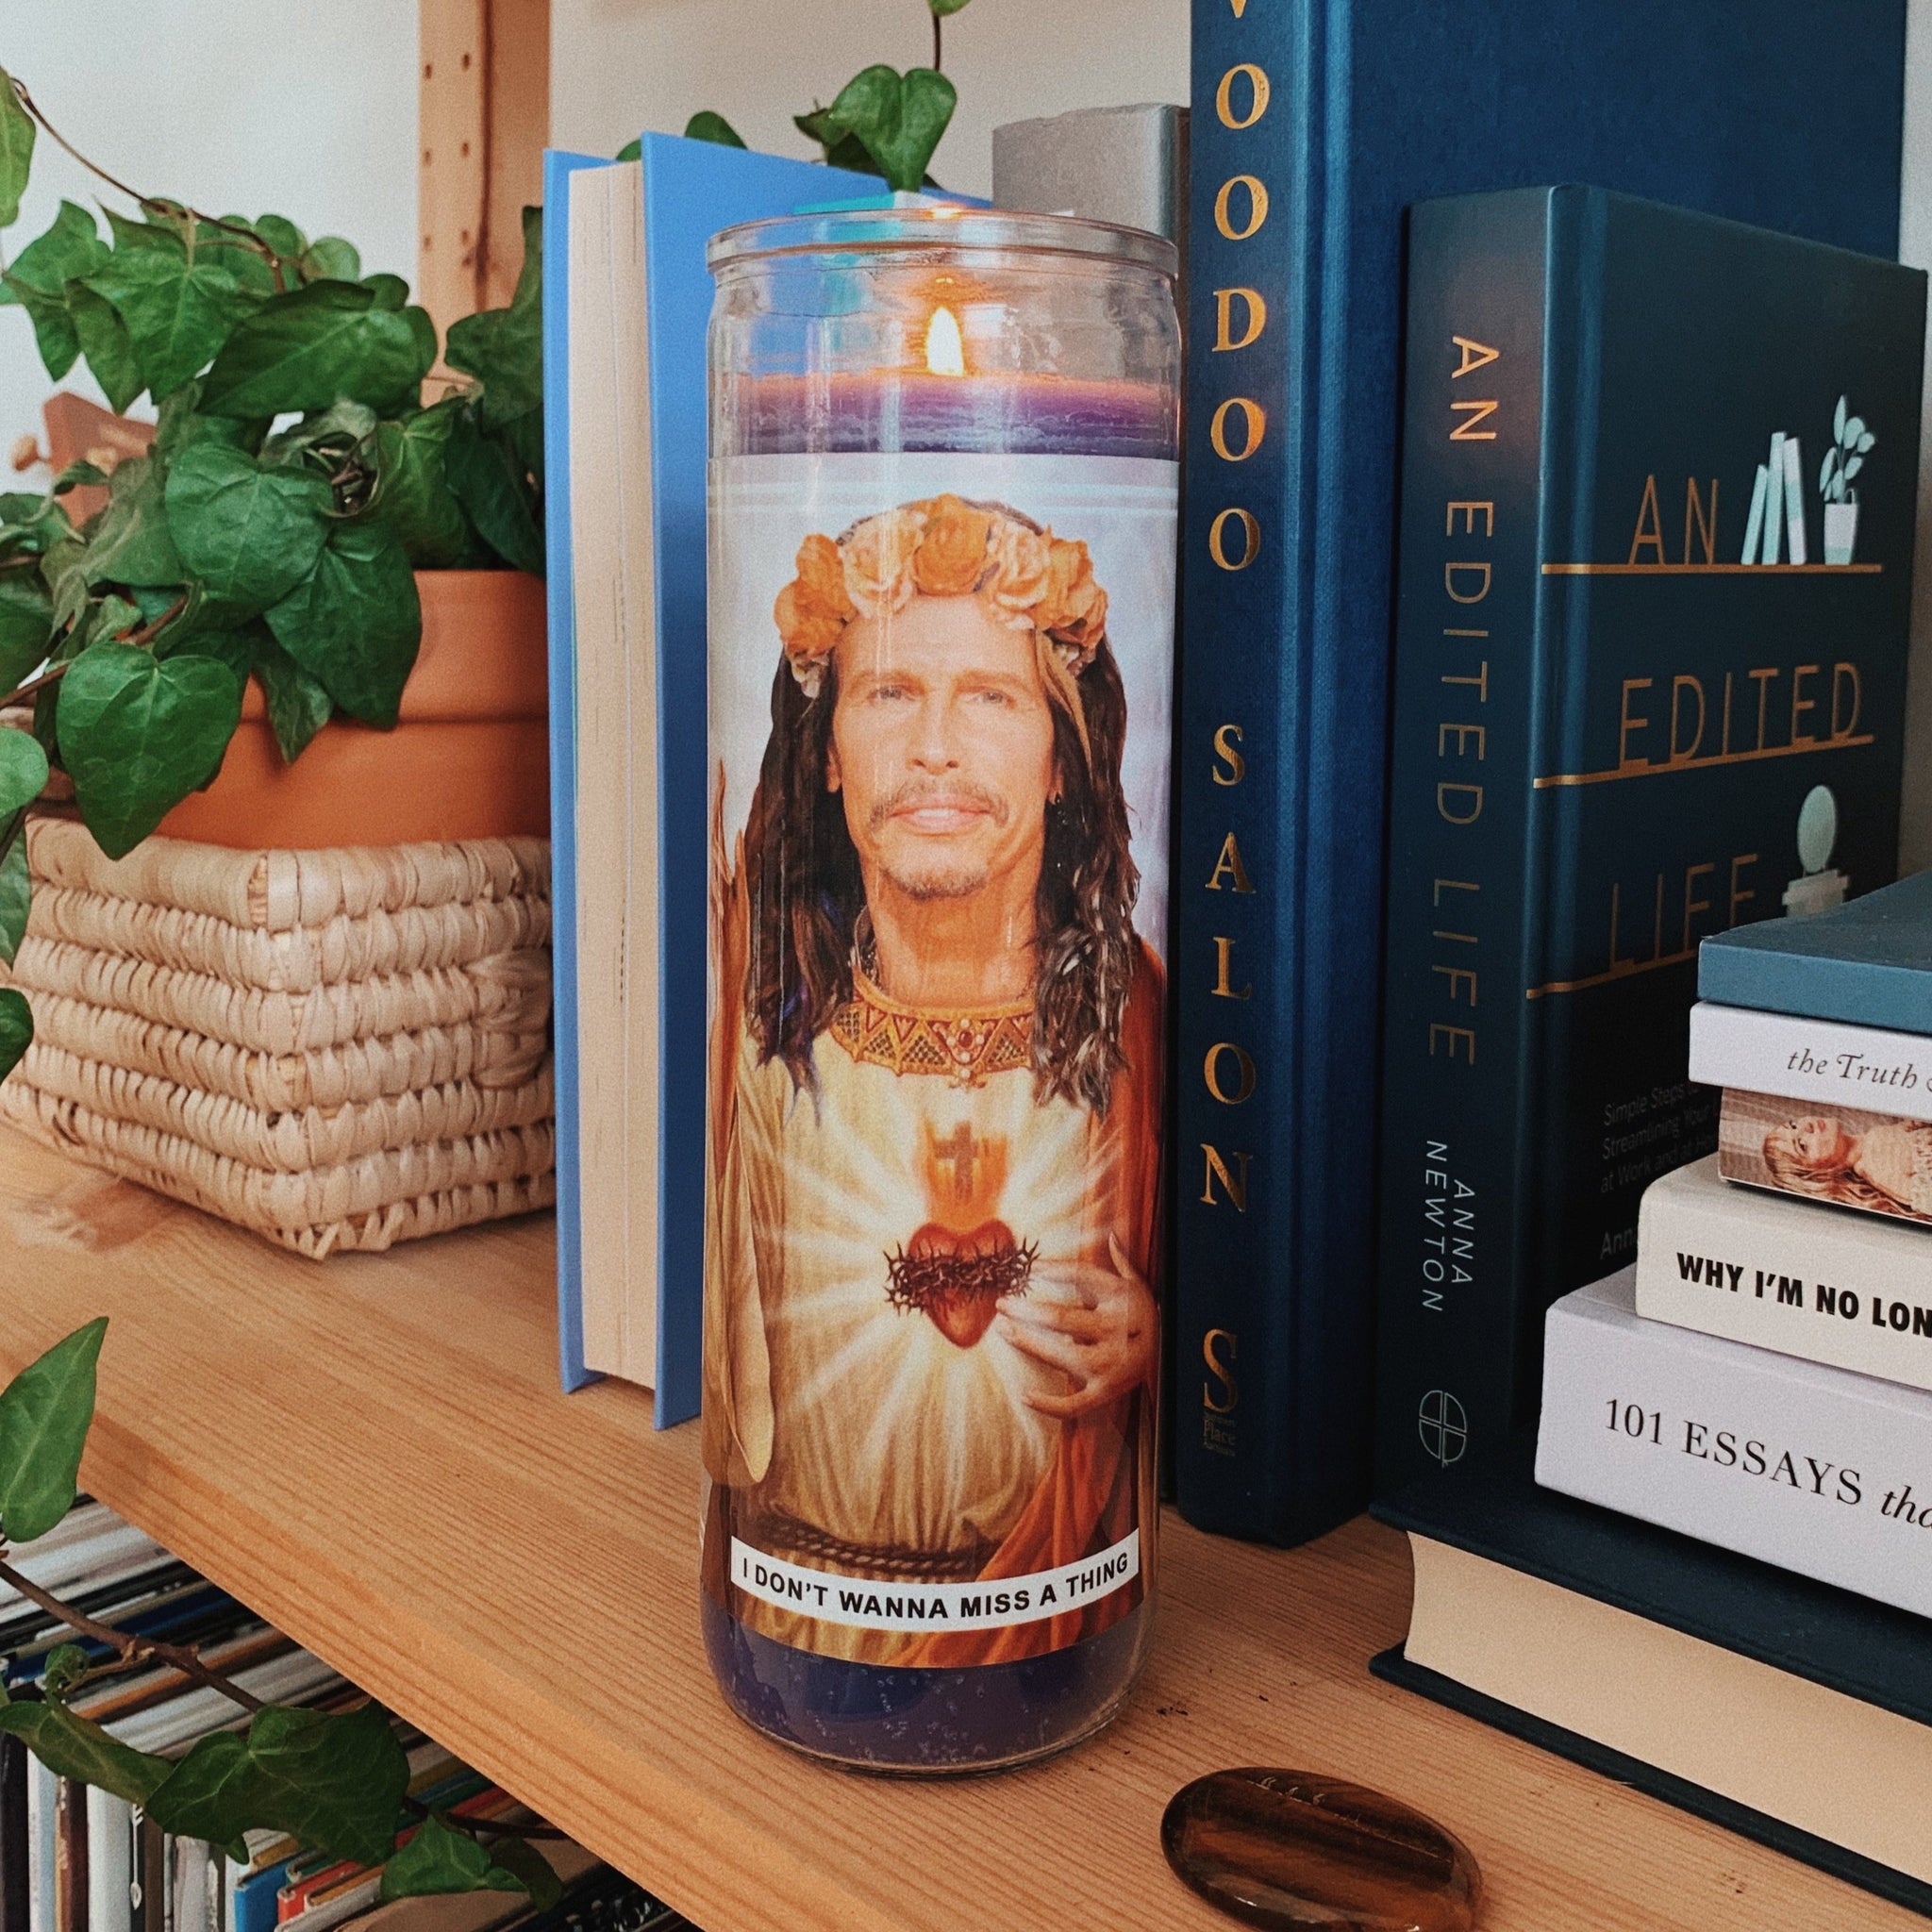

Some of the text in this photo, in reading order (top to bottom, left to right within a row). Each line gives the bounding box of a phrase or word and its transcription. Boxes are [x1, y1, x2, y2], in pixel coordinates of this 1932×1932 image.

[1628, 474, 1719, 565] AN
[1200, 0, 1270, 1213] OODOO SALON
[1429, 335, 1500, 1066] AN EDITED LIFE
[1618, 662, 1861, 770] EDITED
[1603, 1094, 1648, 1127] Simple
[1650, 1083, 1686, 1109] Steps
[1787, 1048, 1828, 1075] the
[1836, 1053, 1918, 1090] Truth
[1600, 1170, 1615, 1194] at
[1617, 1154, 1652, 1186] Work
[1602, 1116, 1681, 1160] Streamlining
[1423, 1141, 1448, 1311] NEWTON
[1452, 1179, 1475, 1283] ANNA
[1599, 1227, 1638, 1261] Ann
[1676, 1252, 1744, 1292] WHY
[1755, 1271, 1803, 1307] I'M
[1816, 1284, 1859, 1320] NO
[1203, 1329, 1238, 1413] S
[1606, 1399, 1662, 1445] 101
[1681, 1420, 1862, 1506] ESSAYS
[742, 1552, 1129, 1620] I DON'T WANNA MISS A THING
